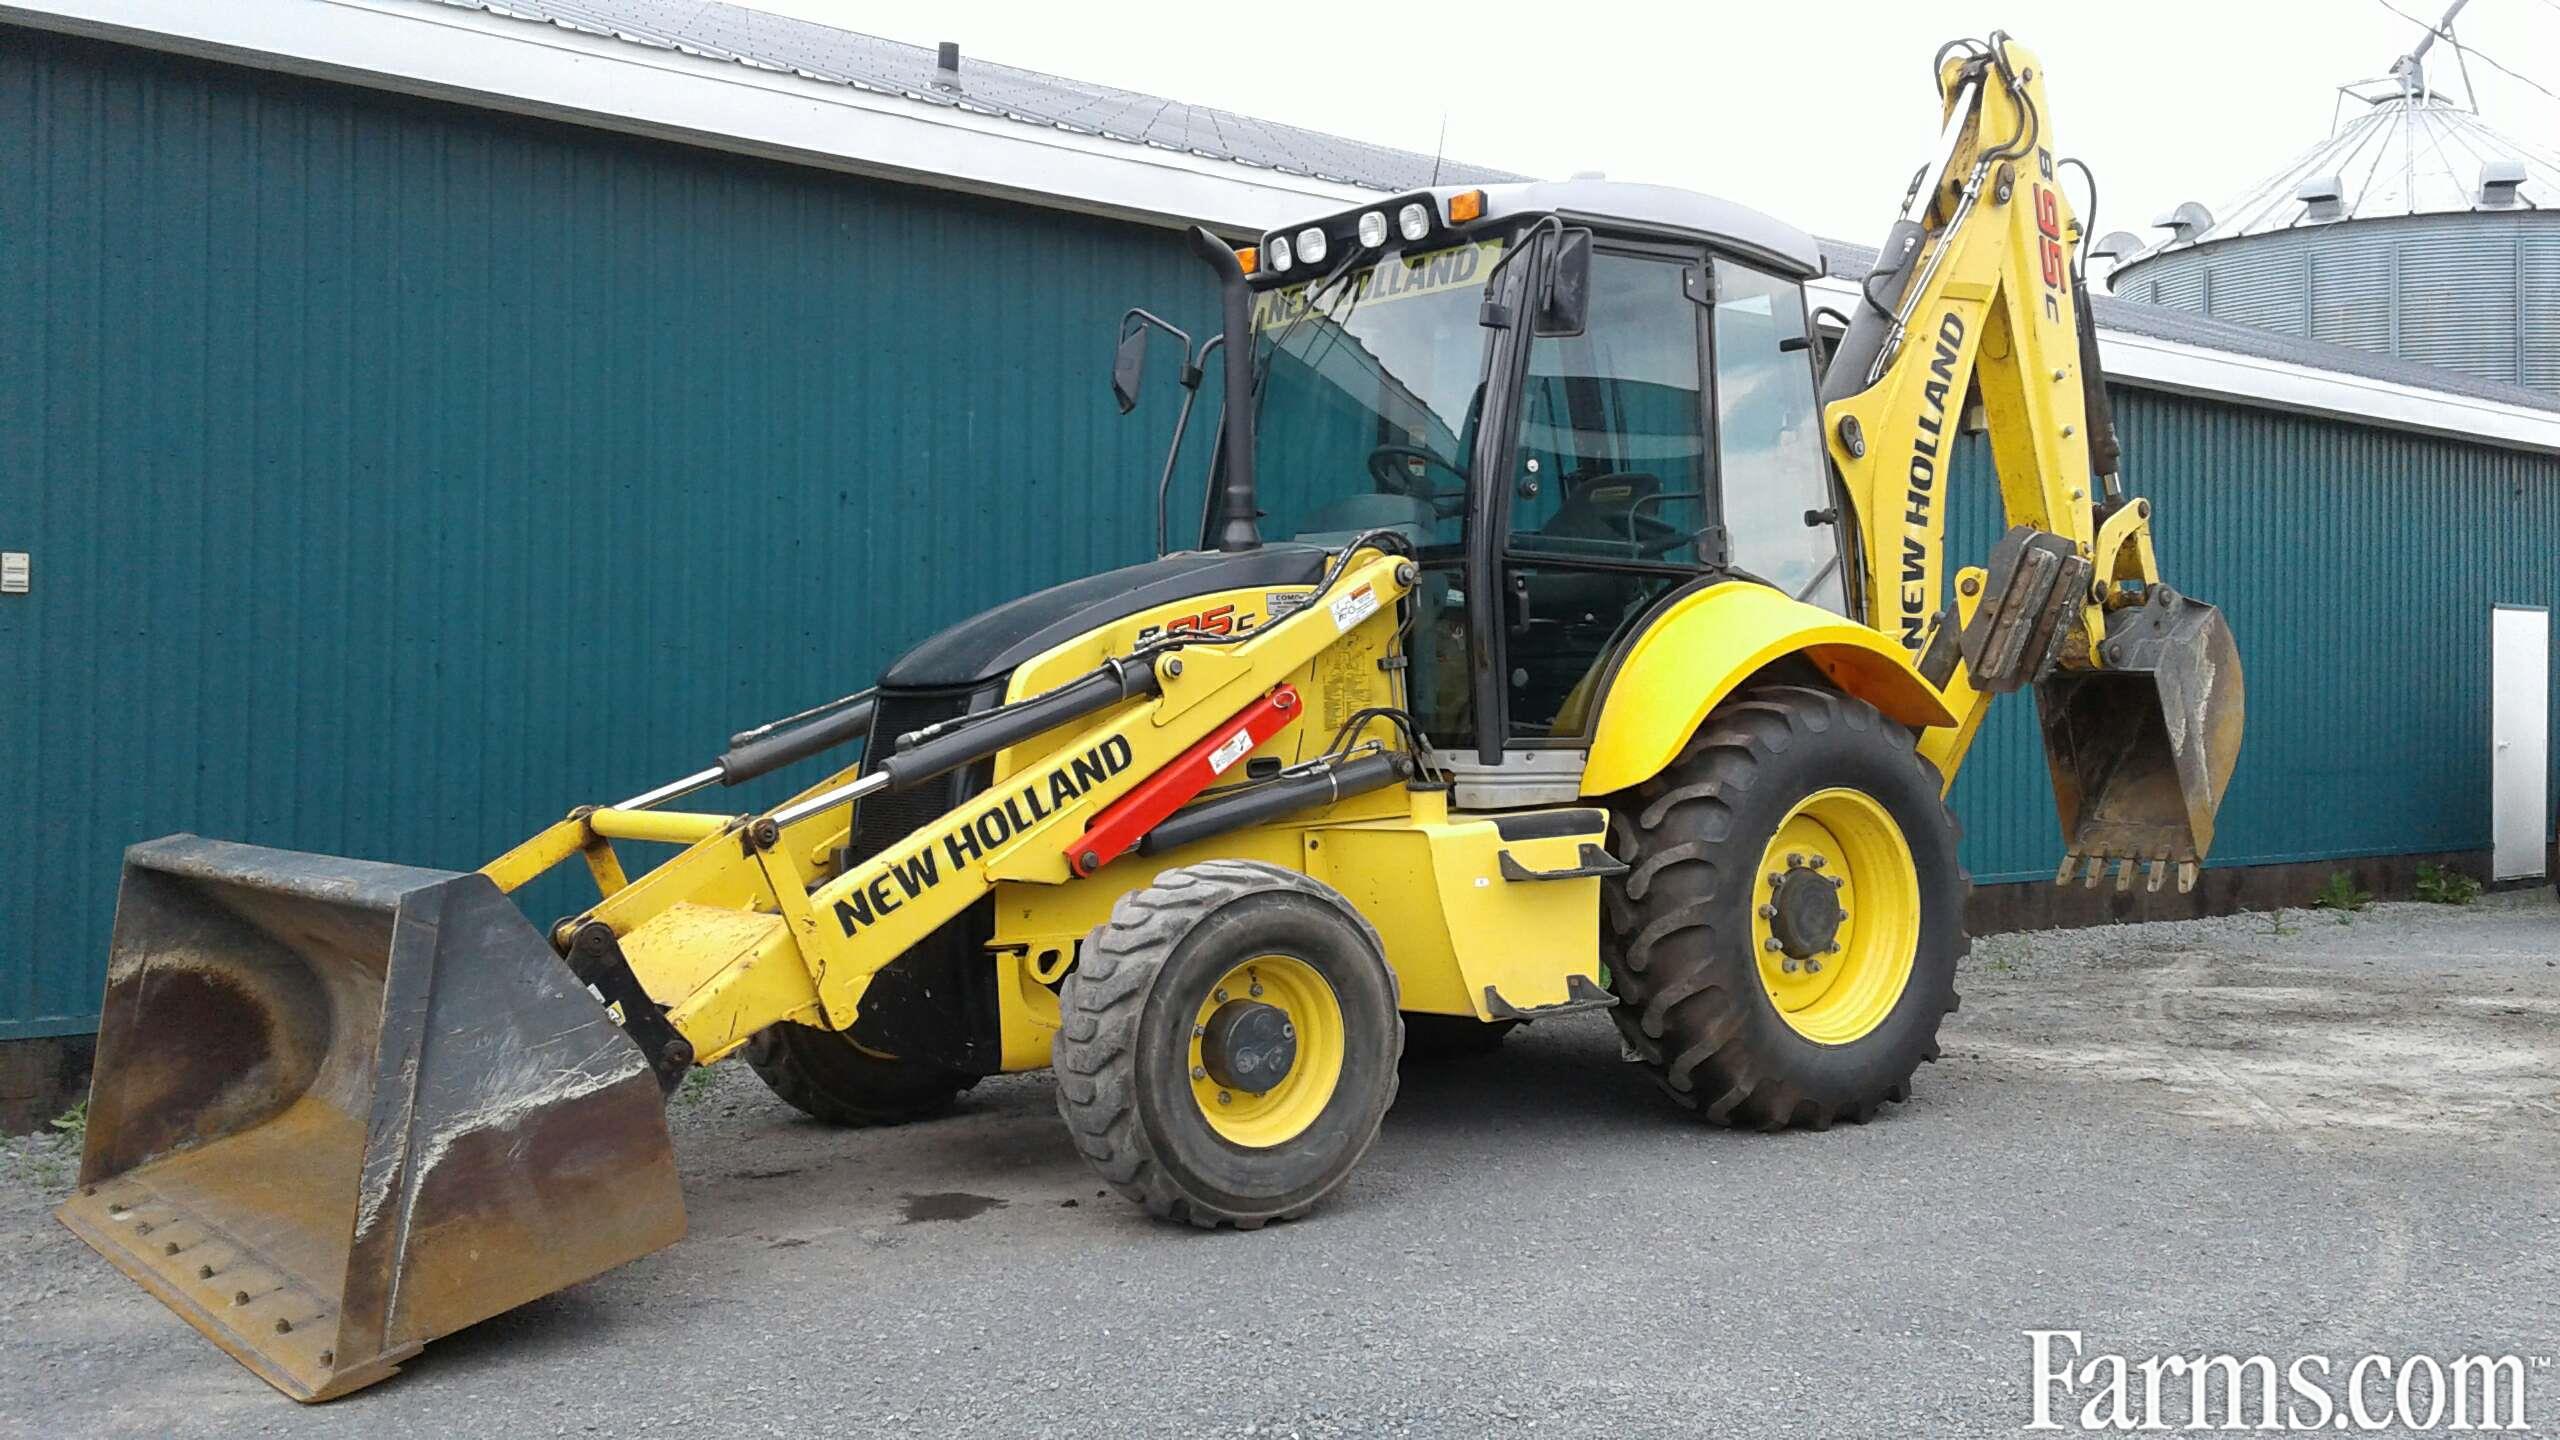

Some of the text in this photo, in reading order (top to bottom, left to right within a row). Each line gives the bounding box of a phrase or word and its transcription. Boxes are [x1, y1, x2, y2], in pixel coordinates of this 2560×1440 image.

[1901, 312, 1965, 650] NEW HOLLAND
[832, 733, 1133, 938] NEW HOLLAND
